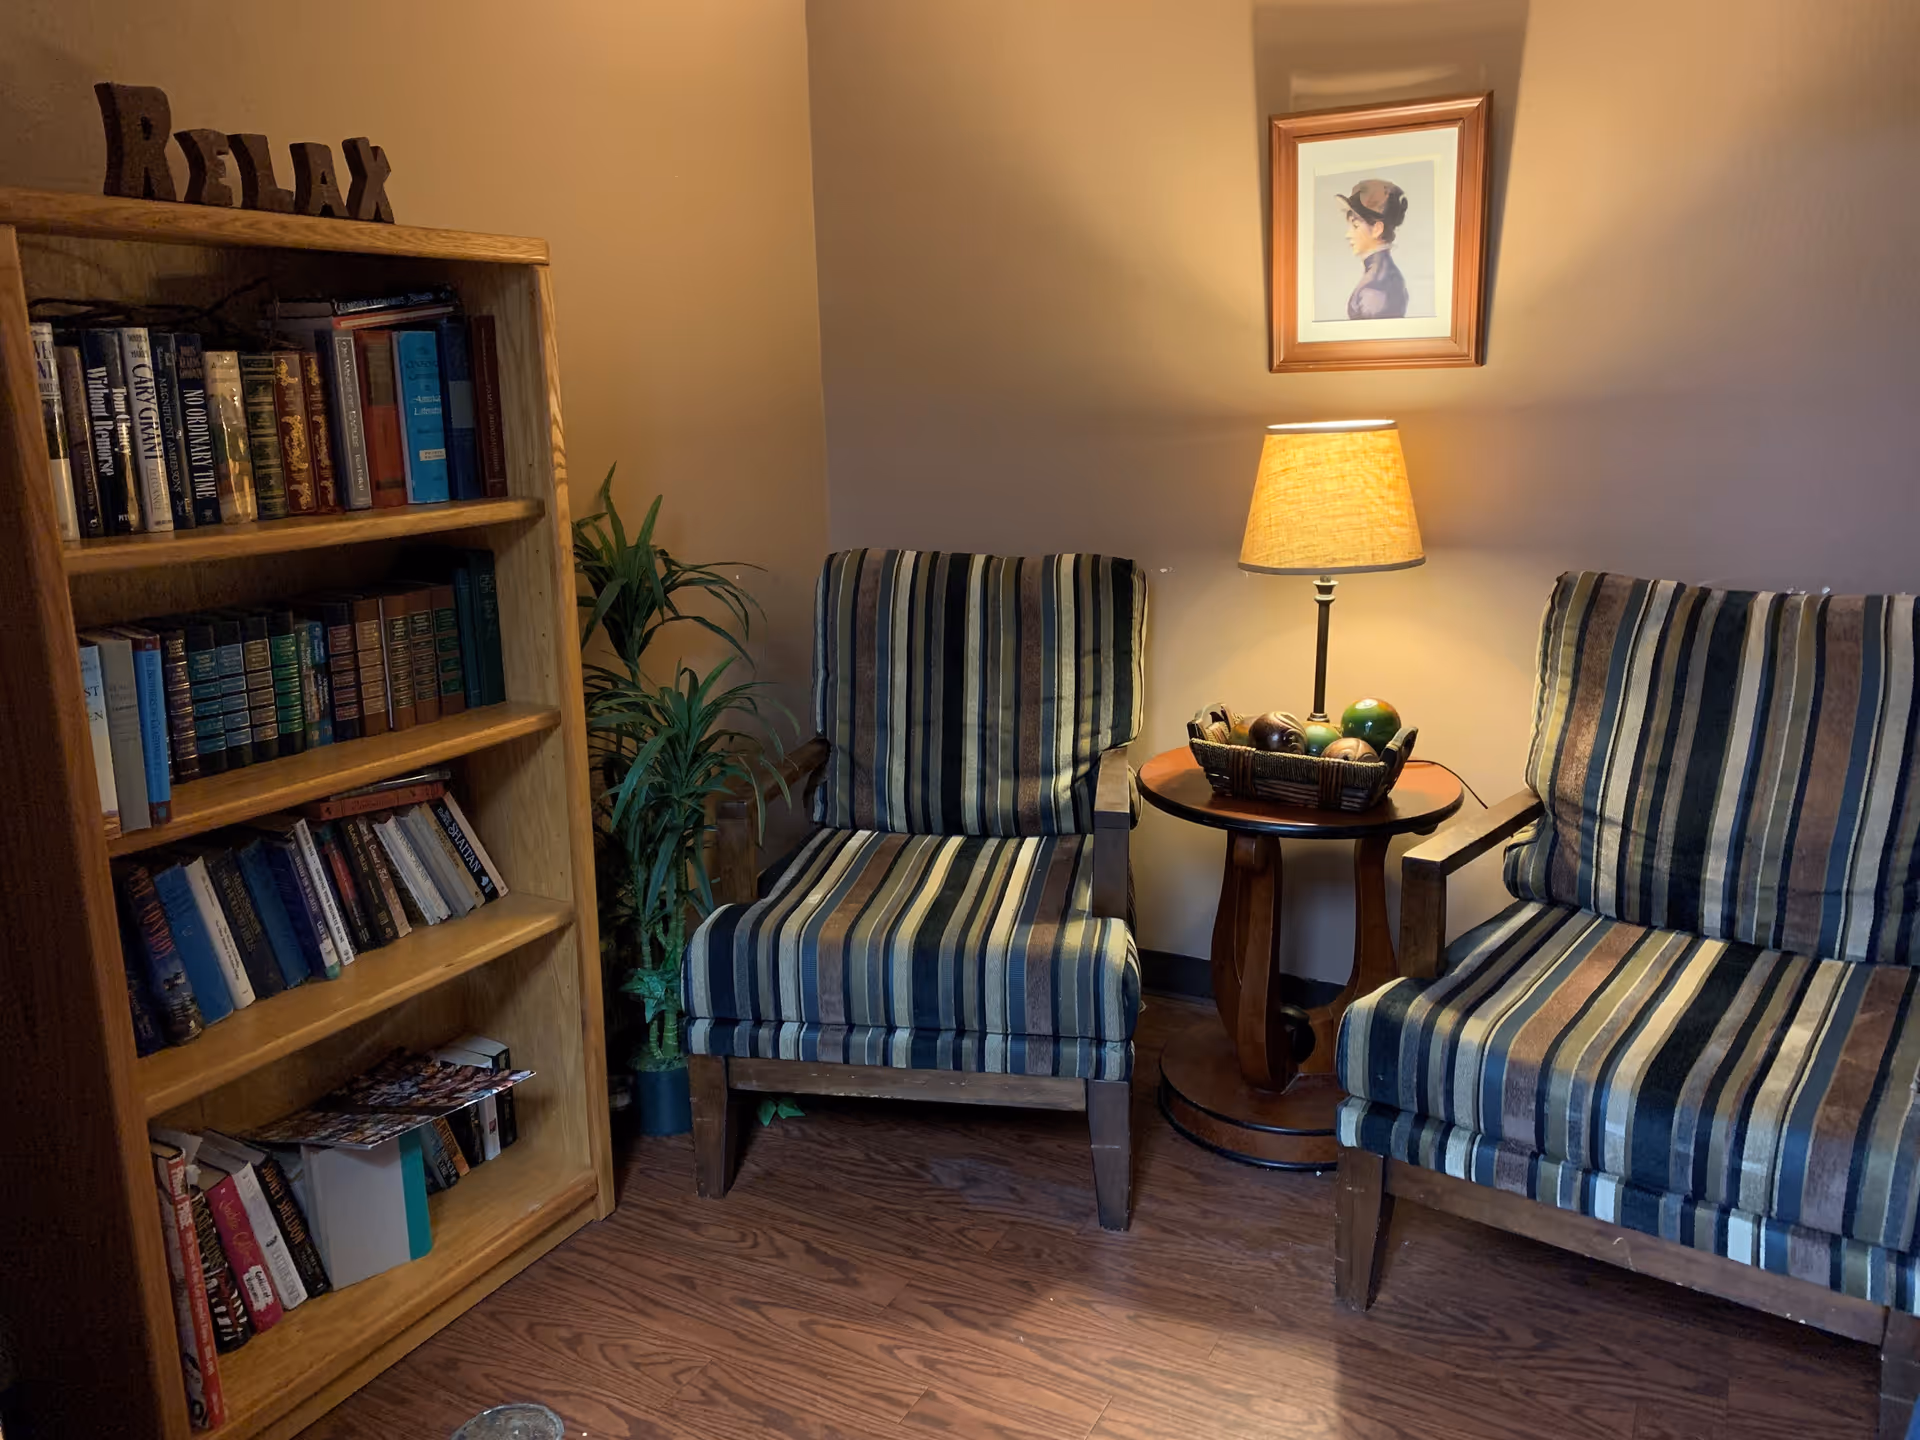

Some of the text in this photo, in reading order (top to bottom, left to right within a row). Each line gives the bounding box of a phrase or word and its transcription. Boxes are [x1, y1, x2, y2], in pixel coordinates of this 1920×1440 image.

[94, 82, 394, 224] RELAX
[87, 366, 114, 476] Without Remorse
[112, 387, 131, 456] Tom Clancy
[132, 363, 164, 460] CARY GRANT
[159, 378, 174, 438] MAGNIFICENT
[168, 441, 182, 493] AMBERSONS
[183, 389, 217, 500] NO ORDINARY TIME
[347, 824, 360, 847] BLACK
[359, 854, 369, 873] BLUE
[448, 822, 482, 873] SHAITAN
[143, 900, 175, 960] CONROY
[262, 1165, 283, 1200] SIDNEY
[276, 1199, 305, 1244] SHELDON
[199, 1325, 209, 1343] Times
